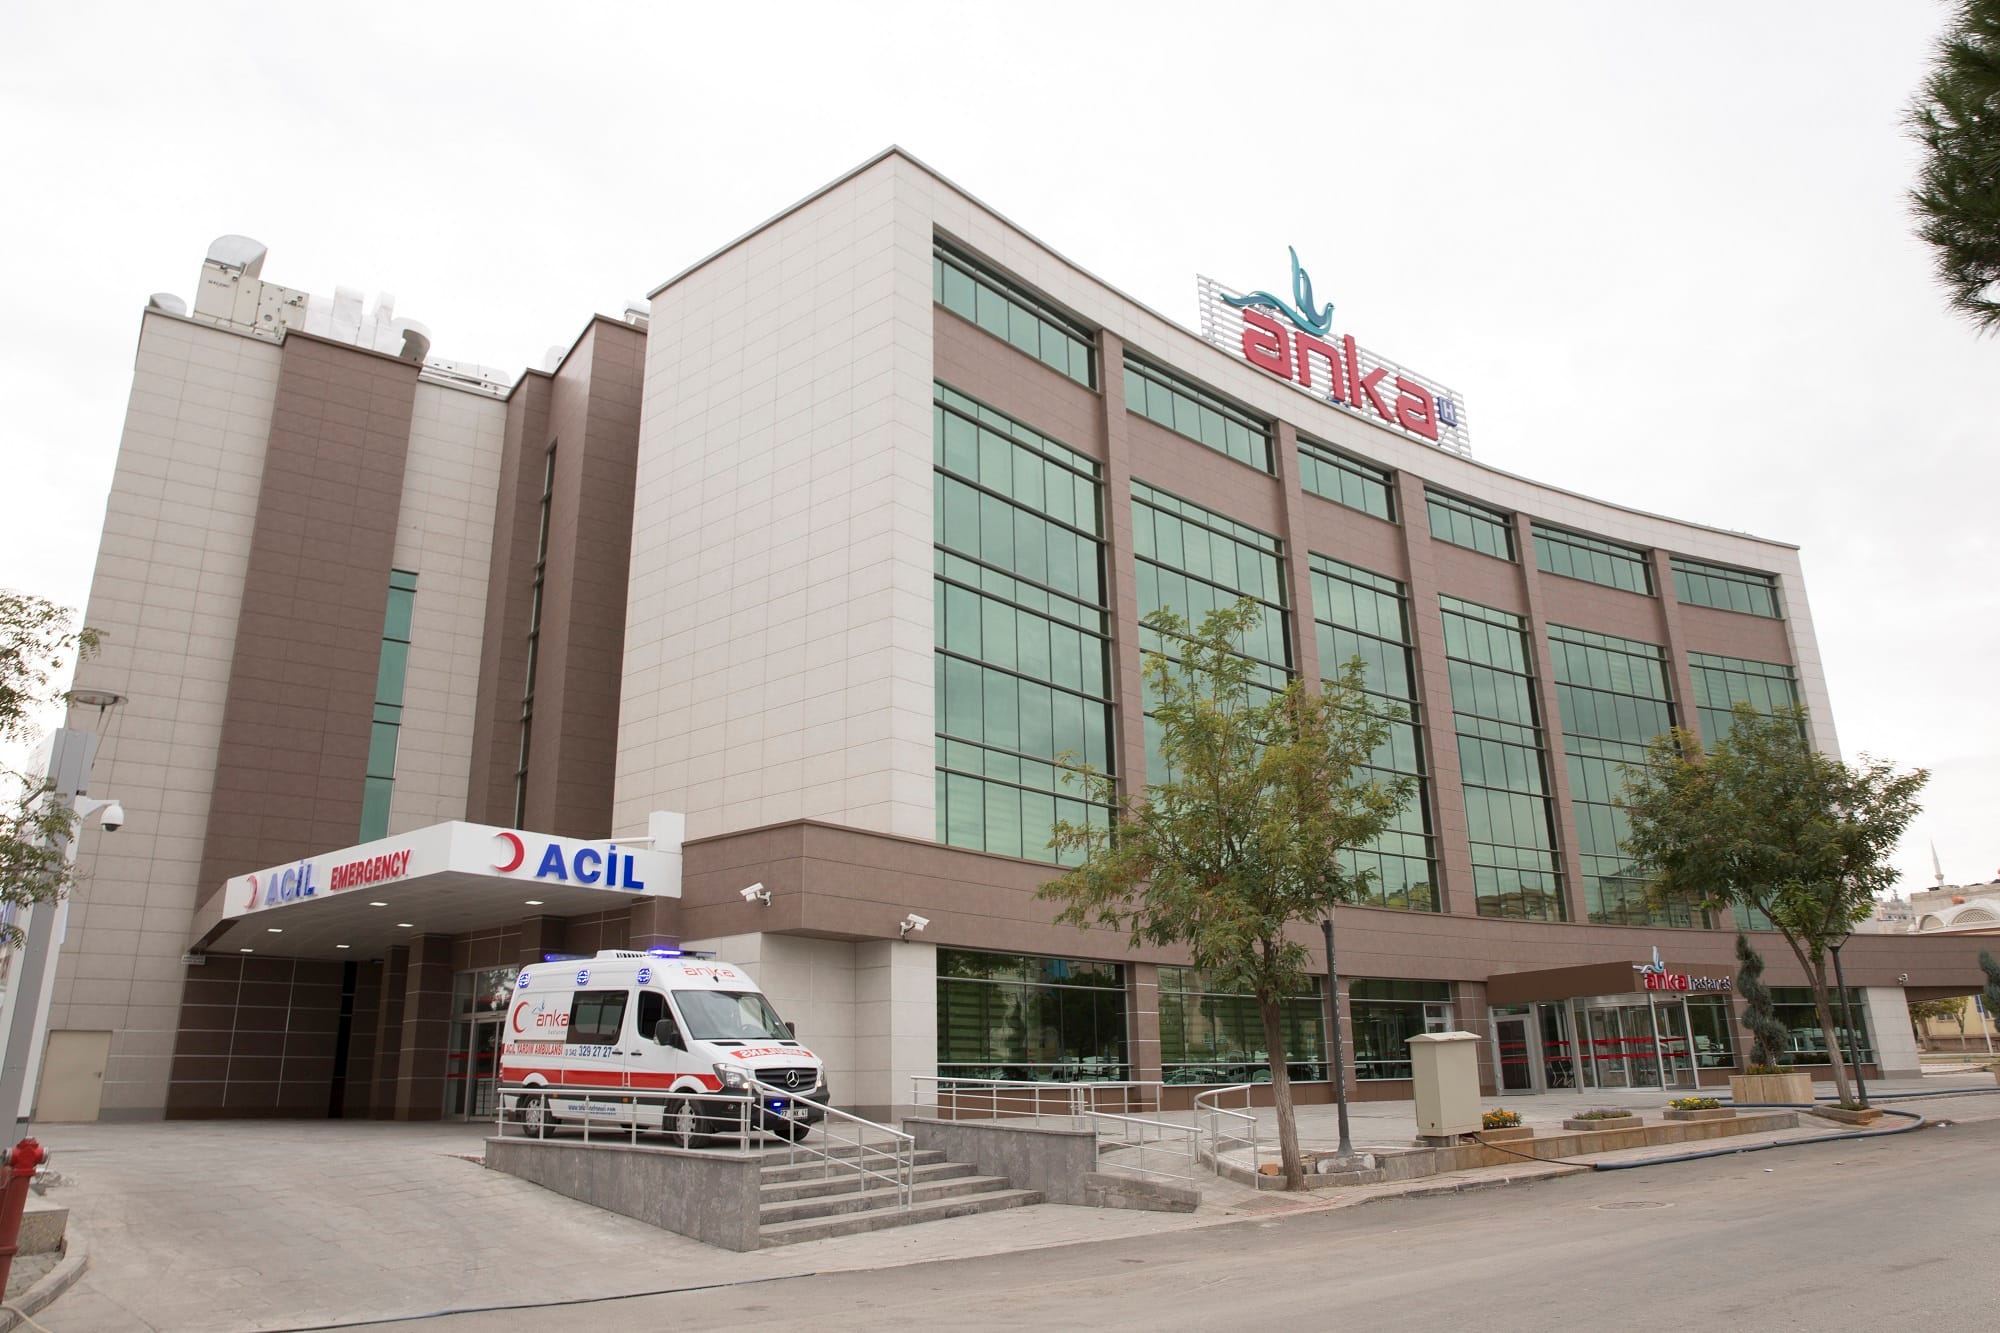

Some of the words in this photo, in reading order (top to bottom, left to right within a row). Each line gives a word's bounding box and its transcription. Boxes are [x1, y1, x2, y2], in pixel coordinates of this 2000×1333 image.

[1241, 308, 1438, 441] anka
[264, 859, 316, 906] ACİL
[330, 849, 411, 891] EMERGENCY
[536, 843, 644, 890] ACİL
[1644, 968, 1687, 990] anka
[536, 1009, 570, 1027] anka
[579, 1046, 591, 1057] 329
[593, 1046, 601, 1057] 27
[603, 1047, 612, 1058] 27
